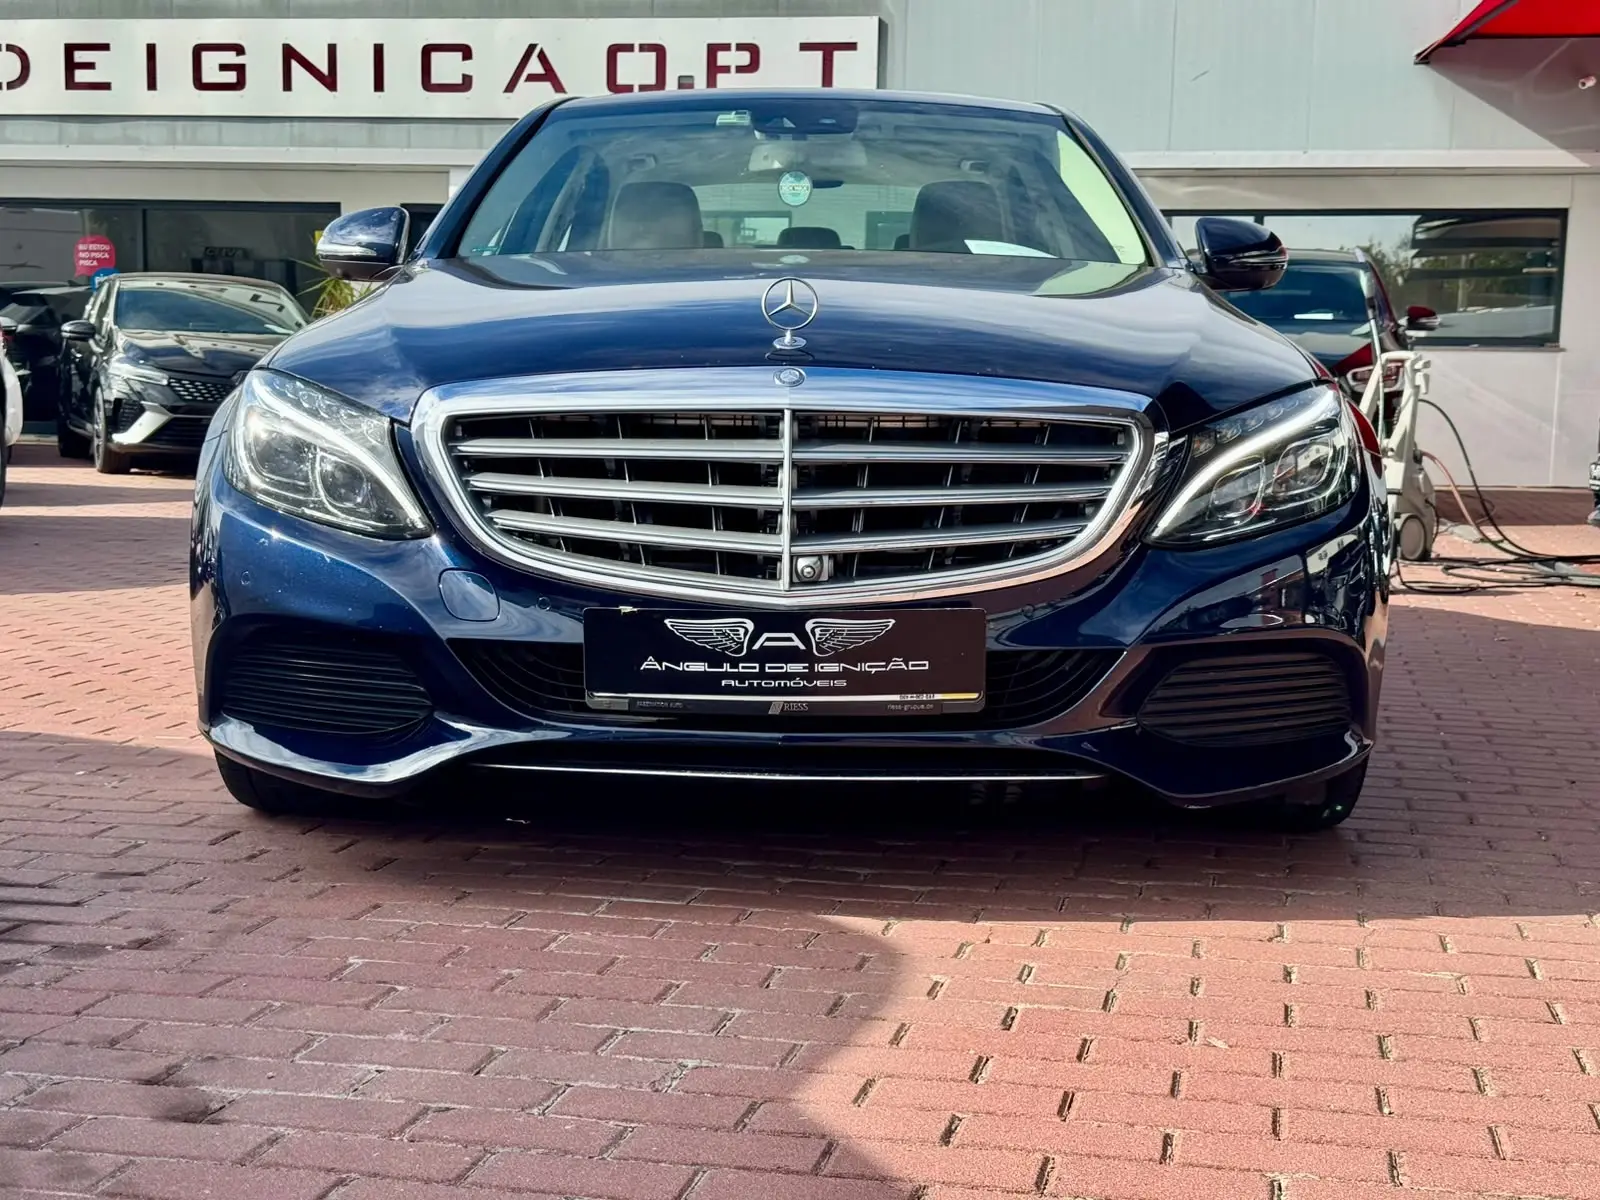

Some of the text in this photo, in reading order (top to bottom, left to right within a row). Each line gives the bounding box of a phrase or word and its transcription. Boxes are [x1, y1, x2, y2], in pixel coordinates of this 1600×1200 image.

[751, 632, 807, 650] A
[640, 655, 929, 674] ÂNGULO DE IGNIÇÃO
[721, 677, 847, 687] AUTOMÓVEIS
[783, 702, 809, 711] RIESS
